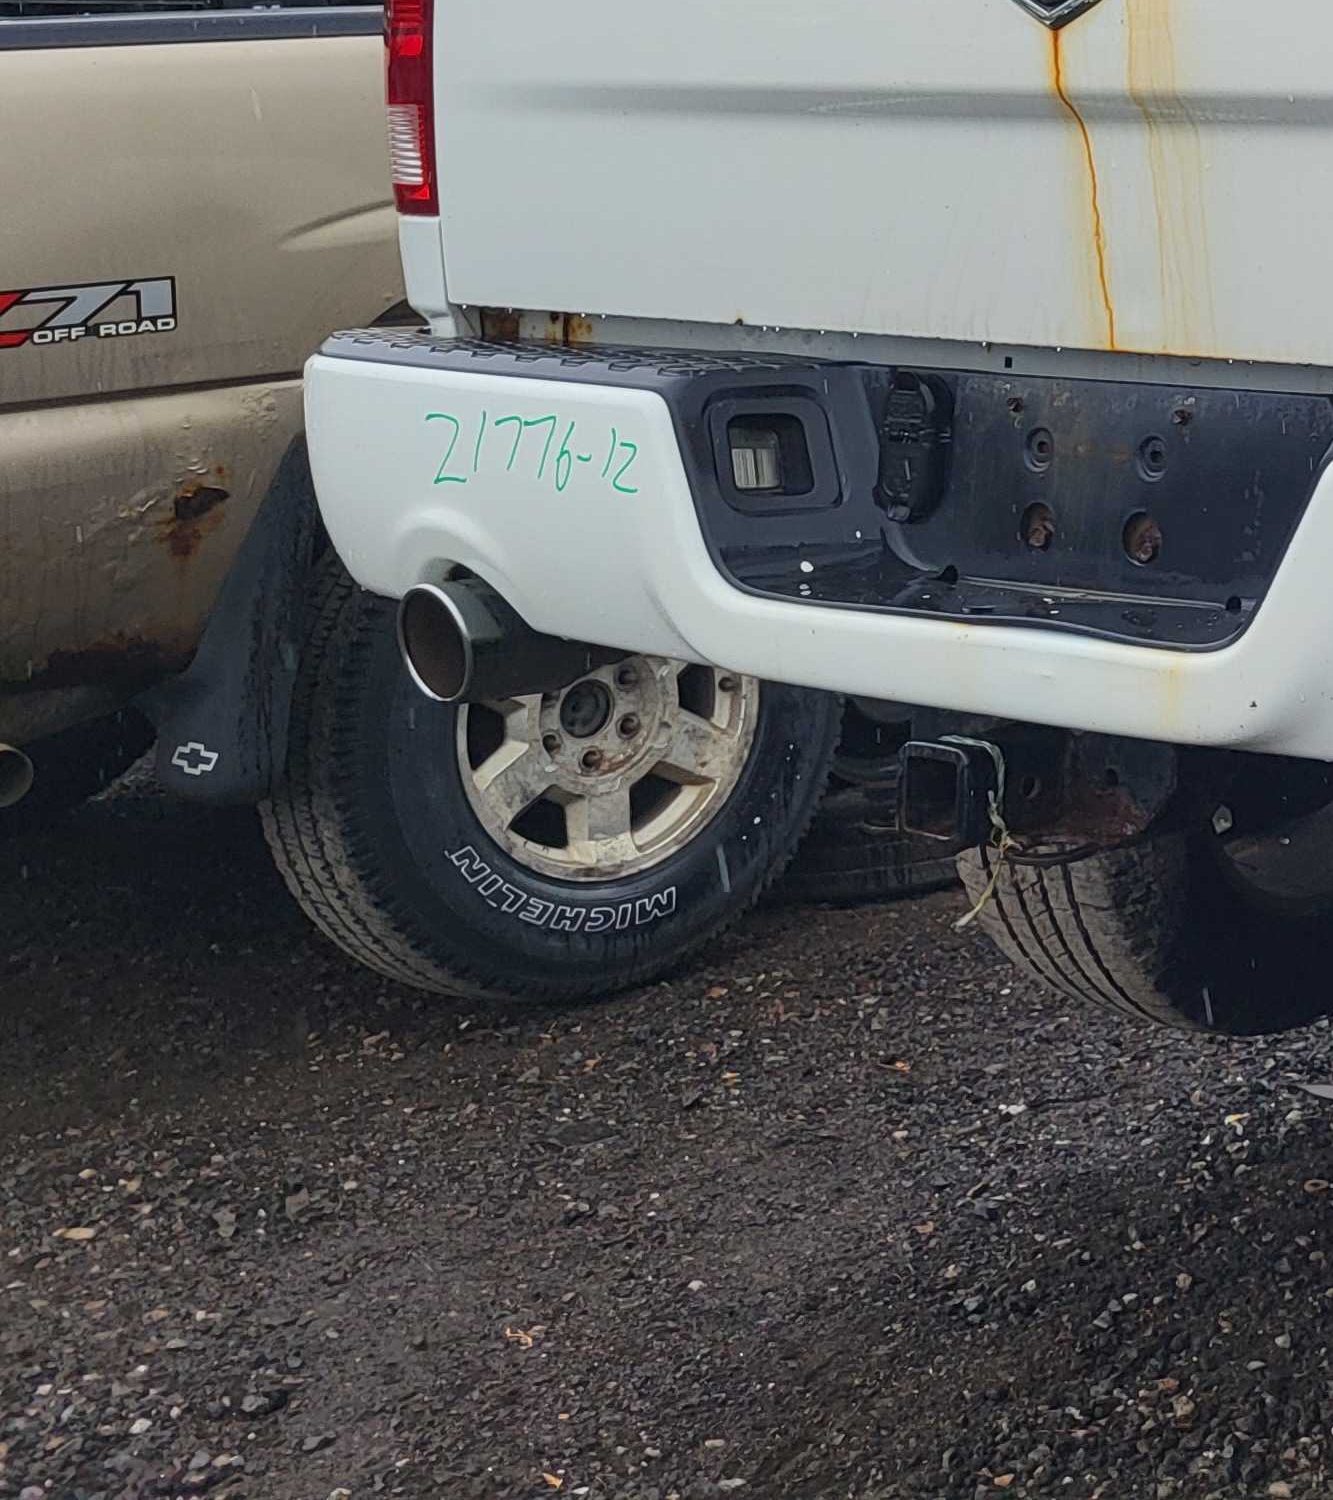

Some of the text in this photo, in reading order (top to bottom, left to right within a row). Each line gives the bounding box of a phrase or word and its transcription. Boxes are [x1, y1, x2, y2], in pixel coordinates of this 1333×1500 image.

[32, 317, 176, 345] OFF ROAD
[425, 409, 639, 494] 21776-12
[449, 845, 678, 932] MICHELIN
